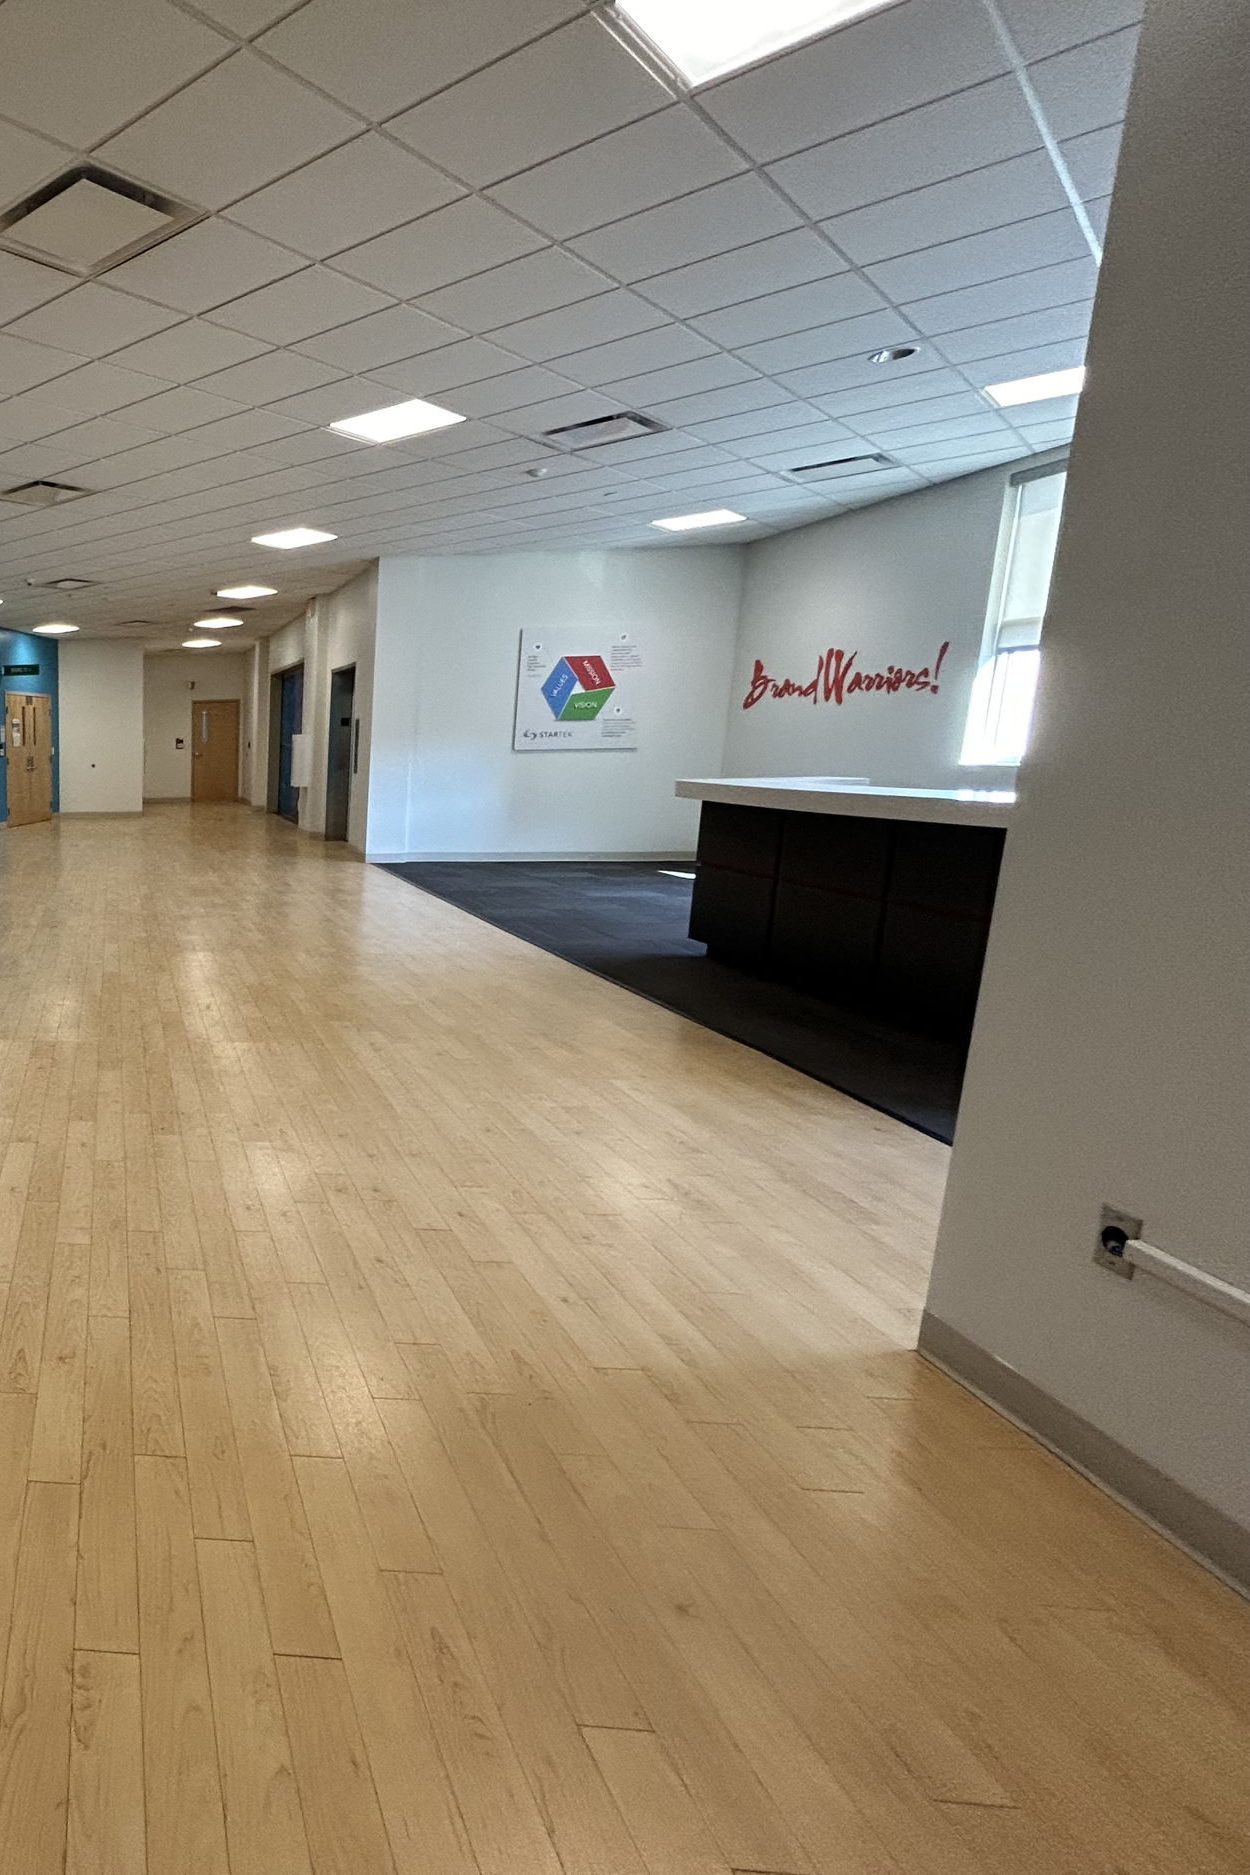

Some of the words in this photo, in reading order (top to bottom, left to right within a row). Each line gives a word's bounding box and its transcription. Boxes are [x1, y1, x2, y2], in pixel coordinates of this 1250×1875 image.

[582, 660, 601, 685] MISSION
[551, 673, 568, 697] VALUES
[573, 701, 598, 709] VISION
[539, 731, 573, 739] STARTEK
